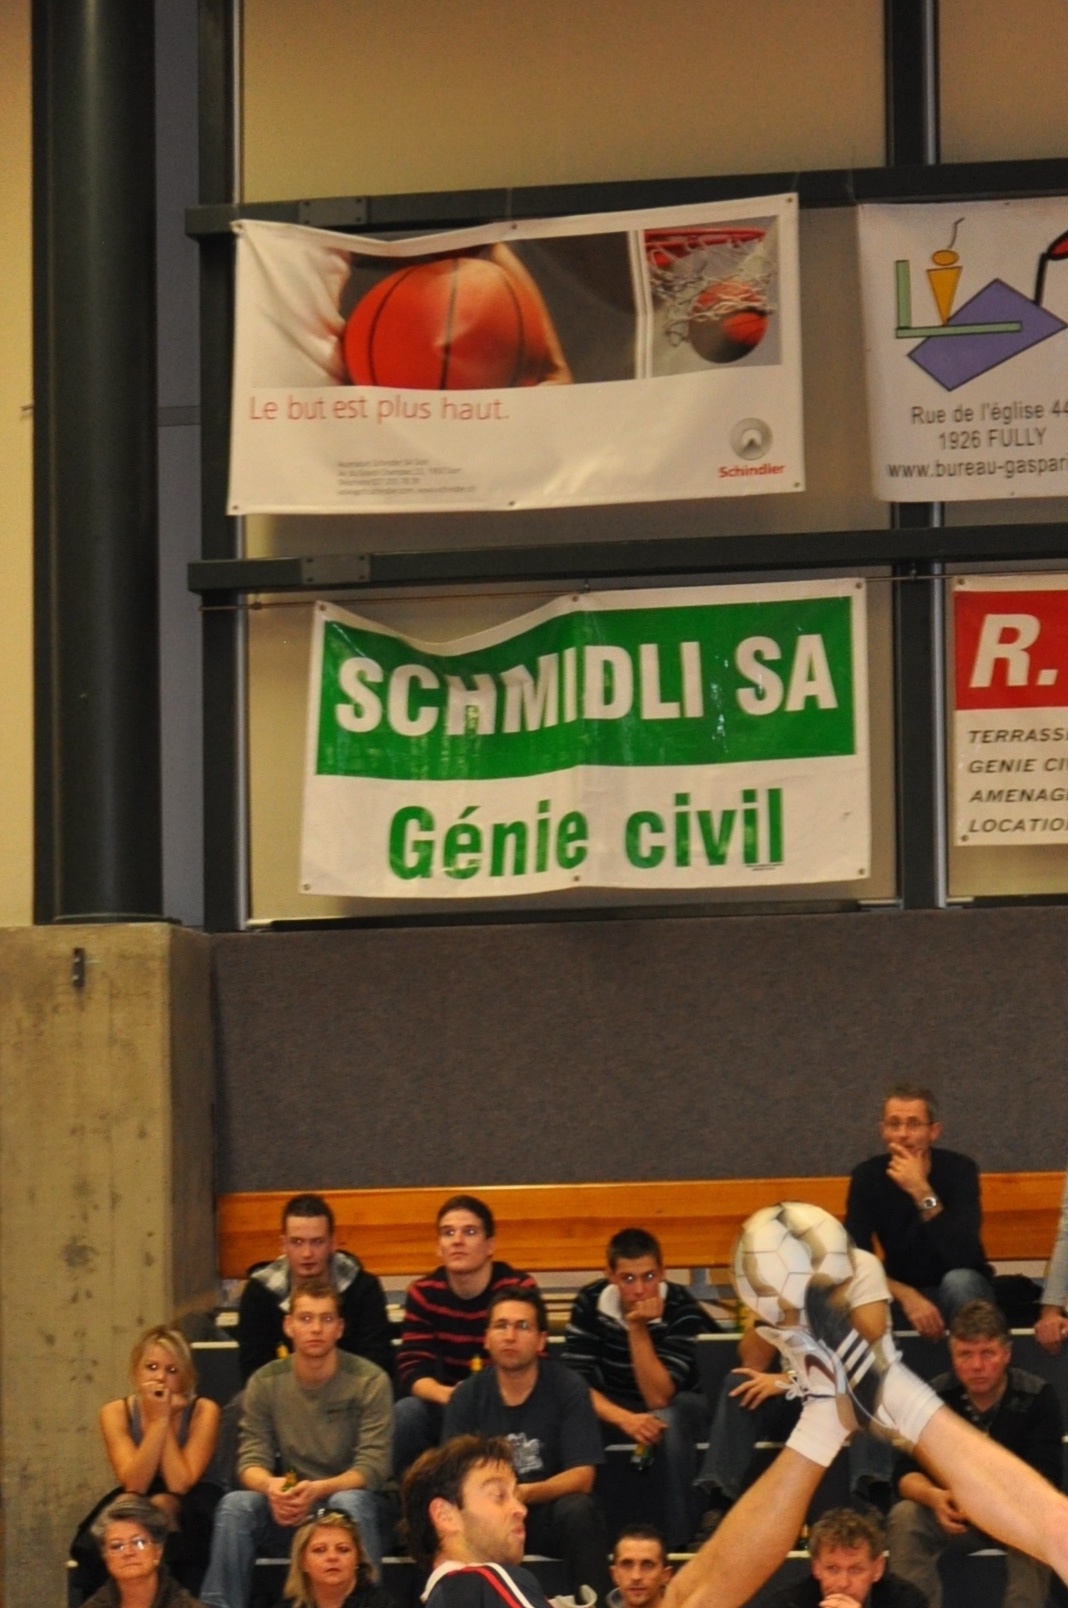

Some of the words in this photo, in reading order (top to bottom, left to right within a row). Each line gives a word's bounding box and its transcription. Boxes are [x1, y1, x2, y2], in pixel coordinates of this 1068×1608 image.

[248, 396, 278, 421] Le
[287, 395, 326, 421] but
[332, 396, 368, 420] est
[377, 395, 430, 424] plus
[440, 398, 511, 422] haut.
[911, 404, 949, 425] Rue
[954, 402, 976, 424] de
[980, 400, 1046, 428] l'église
[938, 430, 983, 450] 1926
[988, 428, 1046, 448] FULLY
[718, 462, 785, 480] Schindler
[969, 614, 1058, 688] R.
[334, 641, 704, 737] SCHMIDLI
[734, 634, 838, 716] SA
[968, 759, 1038, 775] GENIE
[388, 800, 588, 880] Génie
[624, 788, 784, 870] civil
